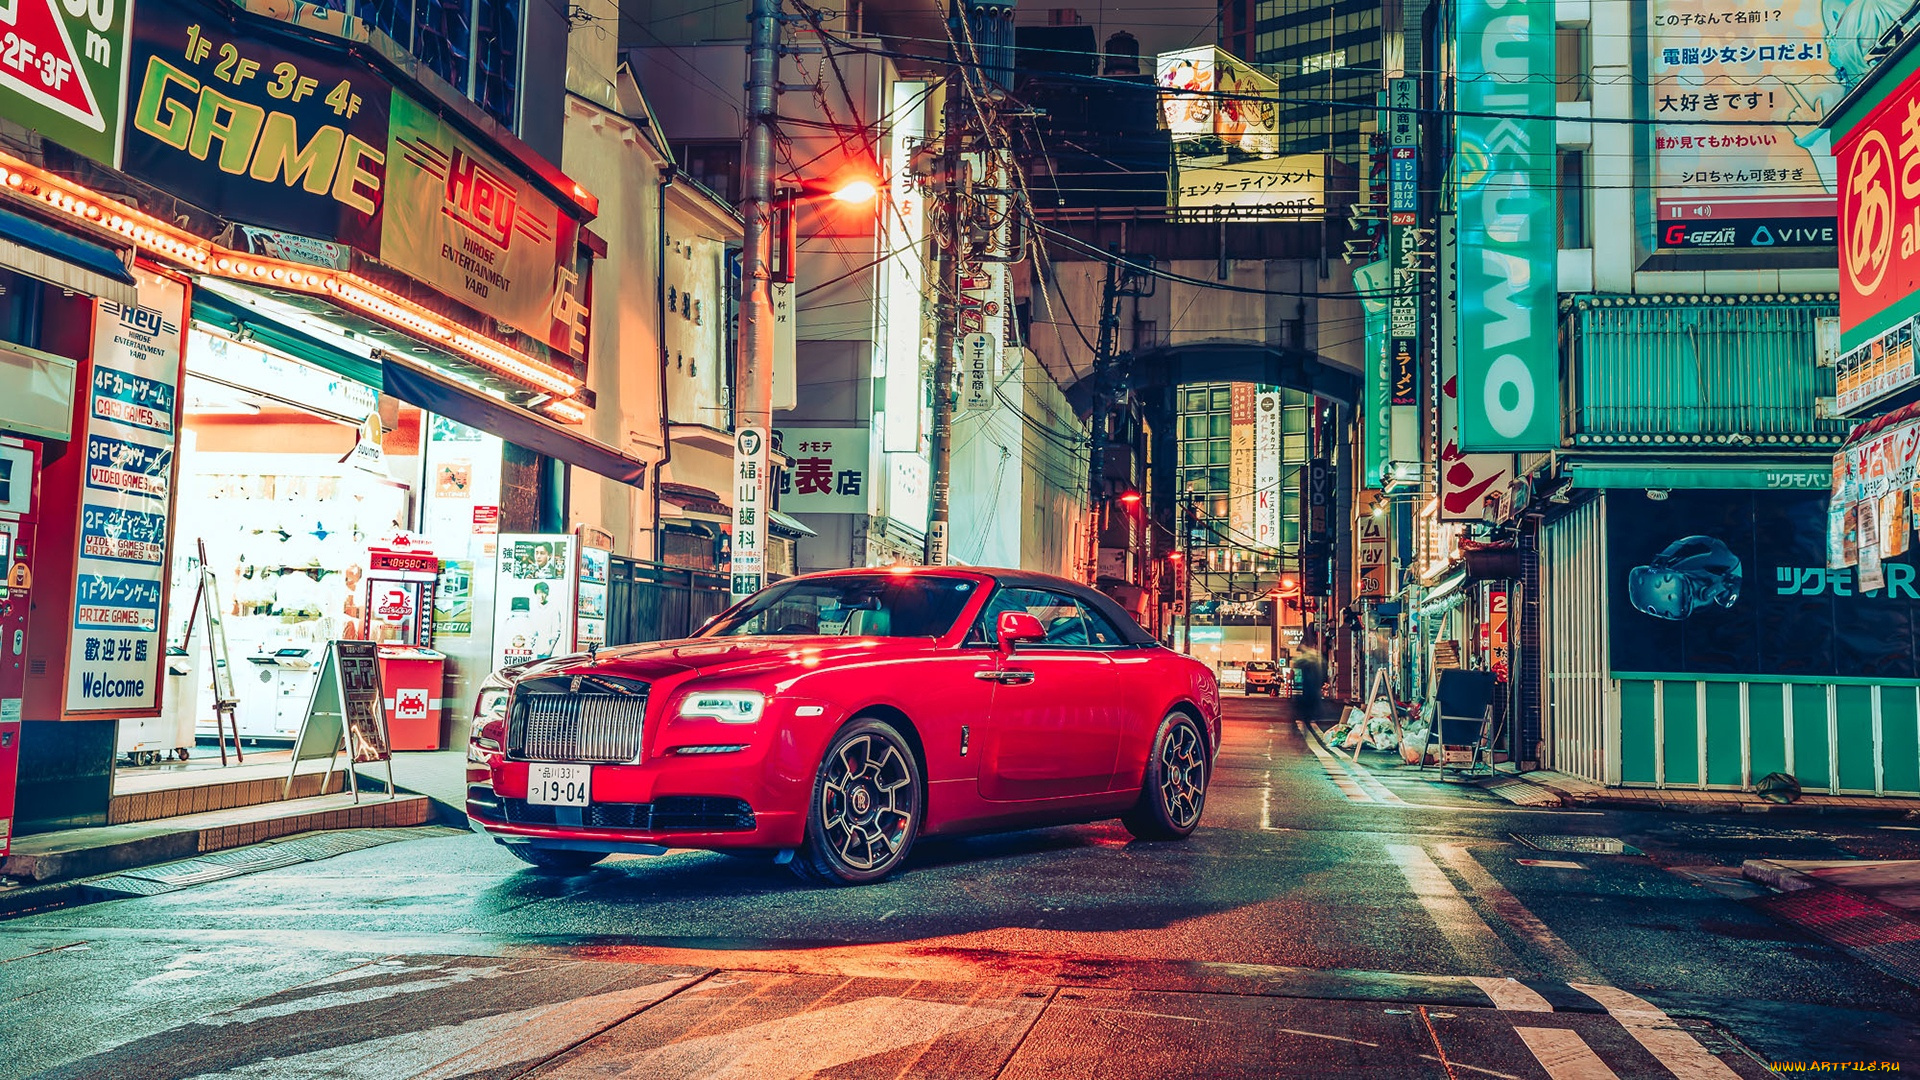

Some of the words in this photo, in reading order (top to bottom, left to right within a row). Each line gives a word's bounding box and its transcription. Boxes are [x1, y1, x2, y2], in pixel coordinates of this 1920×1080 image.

[85, 29, 111, 68] m
[185, 24, 213, 65] 1F
[214, 43, 261, 85] 2F
[266, 62, 316, 104] 3F
[326, 78, 363, 120] 4F
[1659, 92, 1774, 112] 大好きです！
[134, 54, 386, 217] GAME
[1397, 149, 1410, 158] 4F
[1404, 162, 1414, 208] らしんばん
[1682, 167, 1804, 183] シロちゃん可愛すぎ
[443, 146, 518, 252] Hey
[1852, 147, 1891, 276] あ
[1481, 0, 1535, 439] UKUMO
[1665, 225, 1735, 244] G-GEAR
[1778, 228, 1833, 242] VIVE
[463, 237, 495, 265] HIROSE
[441, 244, 511, 292] ENTERTAINMENT
[465, 276, 488, 299] YARD
[120, 304, 163, 336] Hey
[114, 336, 165, 357] ENTERTAINMENT
[129, 331, 151, 344] HIROSE
[130, 349, 146, 360] YARD
[1396, 352, 1412, 396] ラーメン
[97, 399, 122, 418] CARD
[124, 406, 152, 425] GAMES
[798, 442, 832, 452] オモテ
[92, 468, 120, 485] VIDEO
[122, 474, 148, 490] GAMES
[1314, 467, 1325, 505] DVD
[739, 462, 756, 548] 福山歯科
[86, 511, 104, 529] 2F
[86, 536, 116, 548] VIDE
[118, 540, 144, 551] GAMES
[86, 545, 114, 556] PRIZE
[118, 549, 144, 560] GAMES
[502, 548, 513, 573] 強爽
[1777, 566, 1851, 596] ツクモ
[80, 608, 110, 622] PRIZE
[112, 610, 139, 624] GAMES
[85, 637, 148, 662] 歡迎光臨
[83, 672, 144, 698] Welcome
[543, 768, 560, 778] 品川
[543, 781, 585, 803] 19-04
